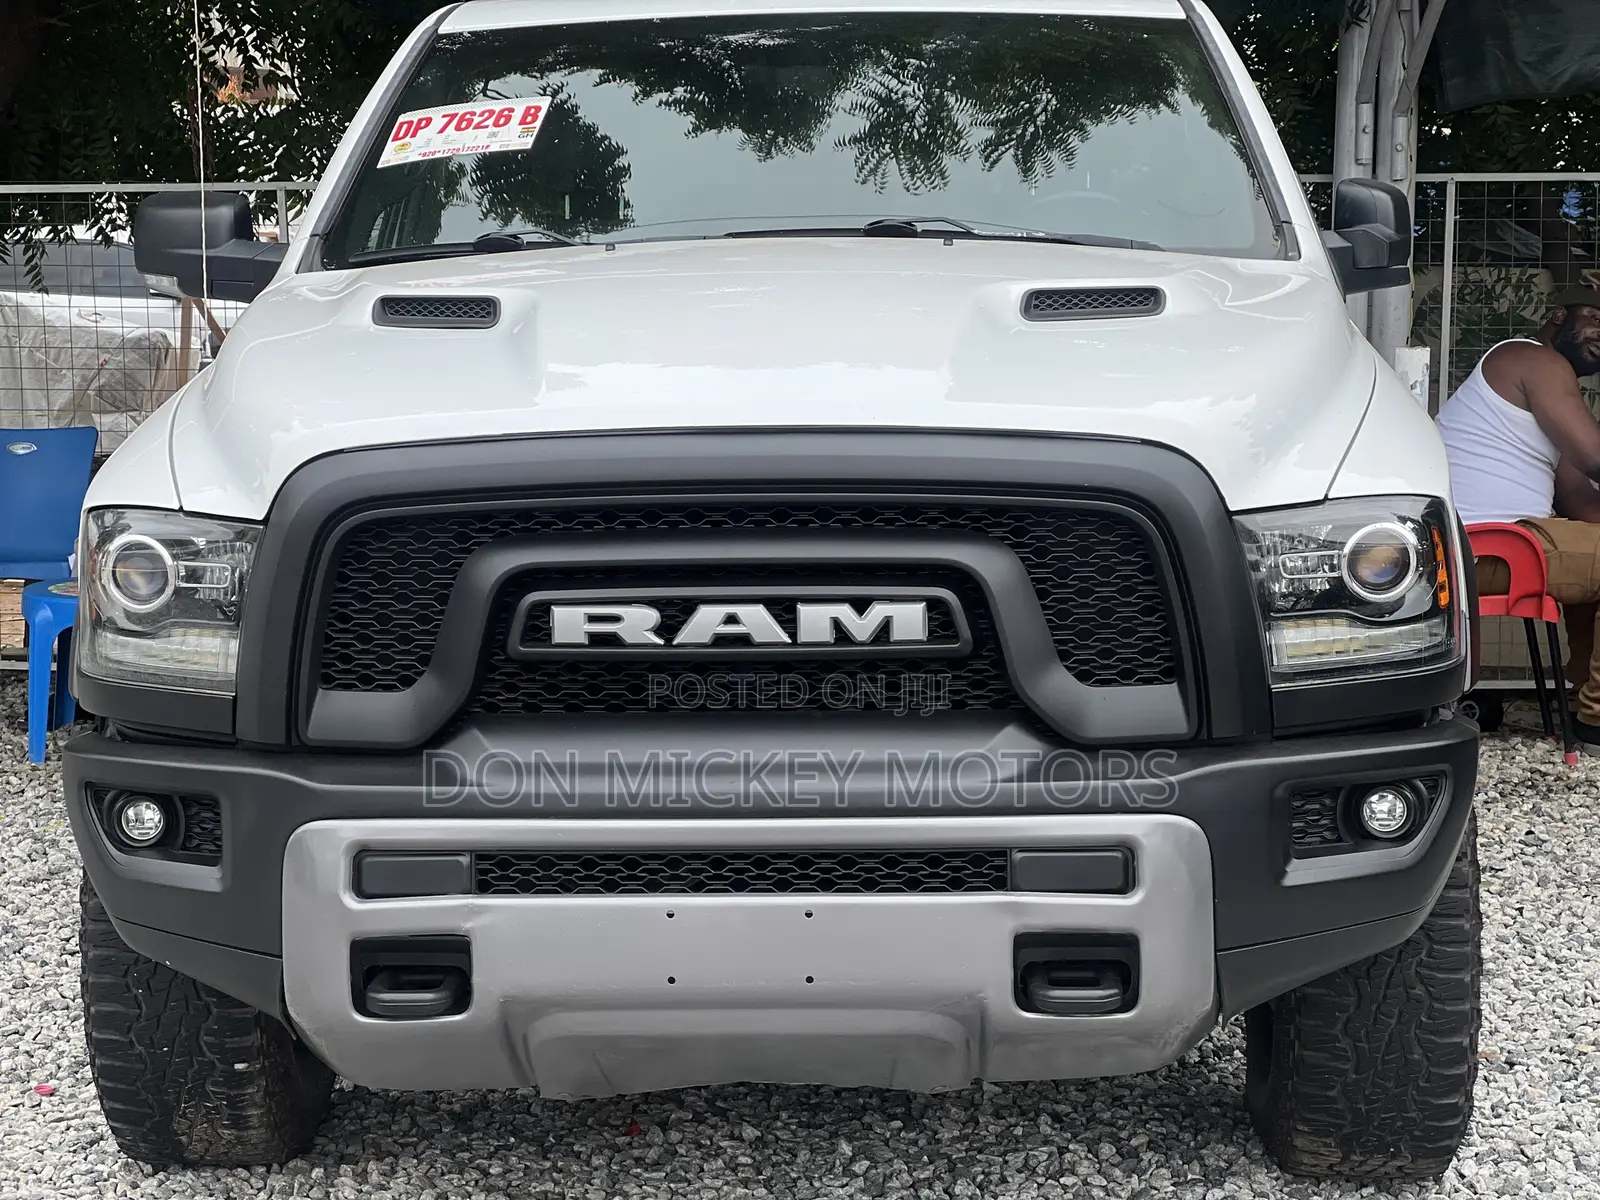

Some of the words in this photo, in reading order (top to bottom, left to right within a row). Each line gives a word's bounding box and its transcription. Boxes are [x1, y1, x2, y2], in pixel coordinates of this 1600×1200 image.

[391, 116, 433, 142] DP
[436, 107, 516, 134] 7626
[518, 105, 543, 126] B
[550, 601, 929, 645] RAM
